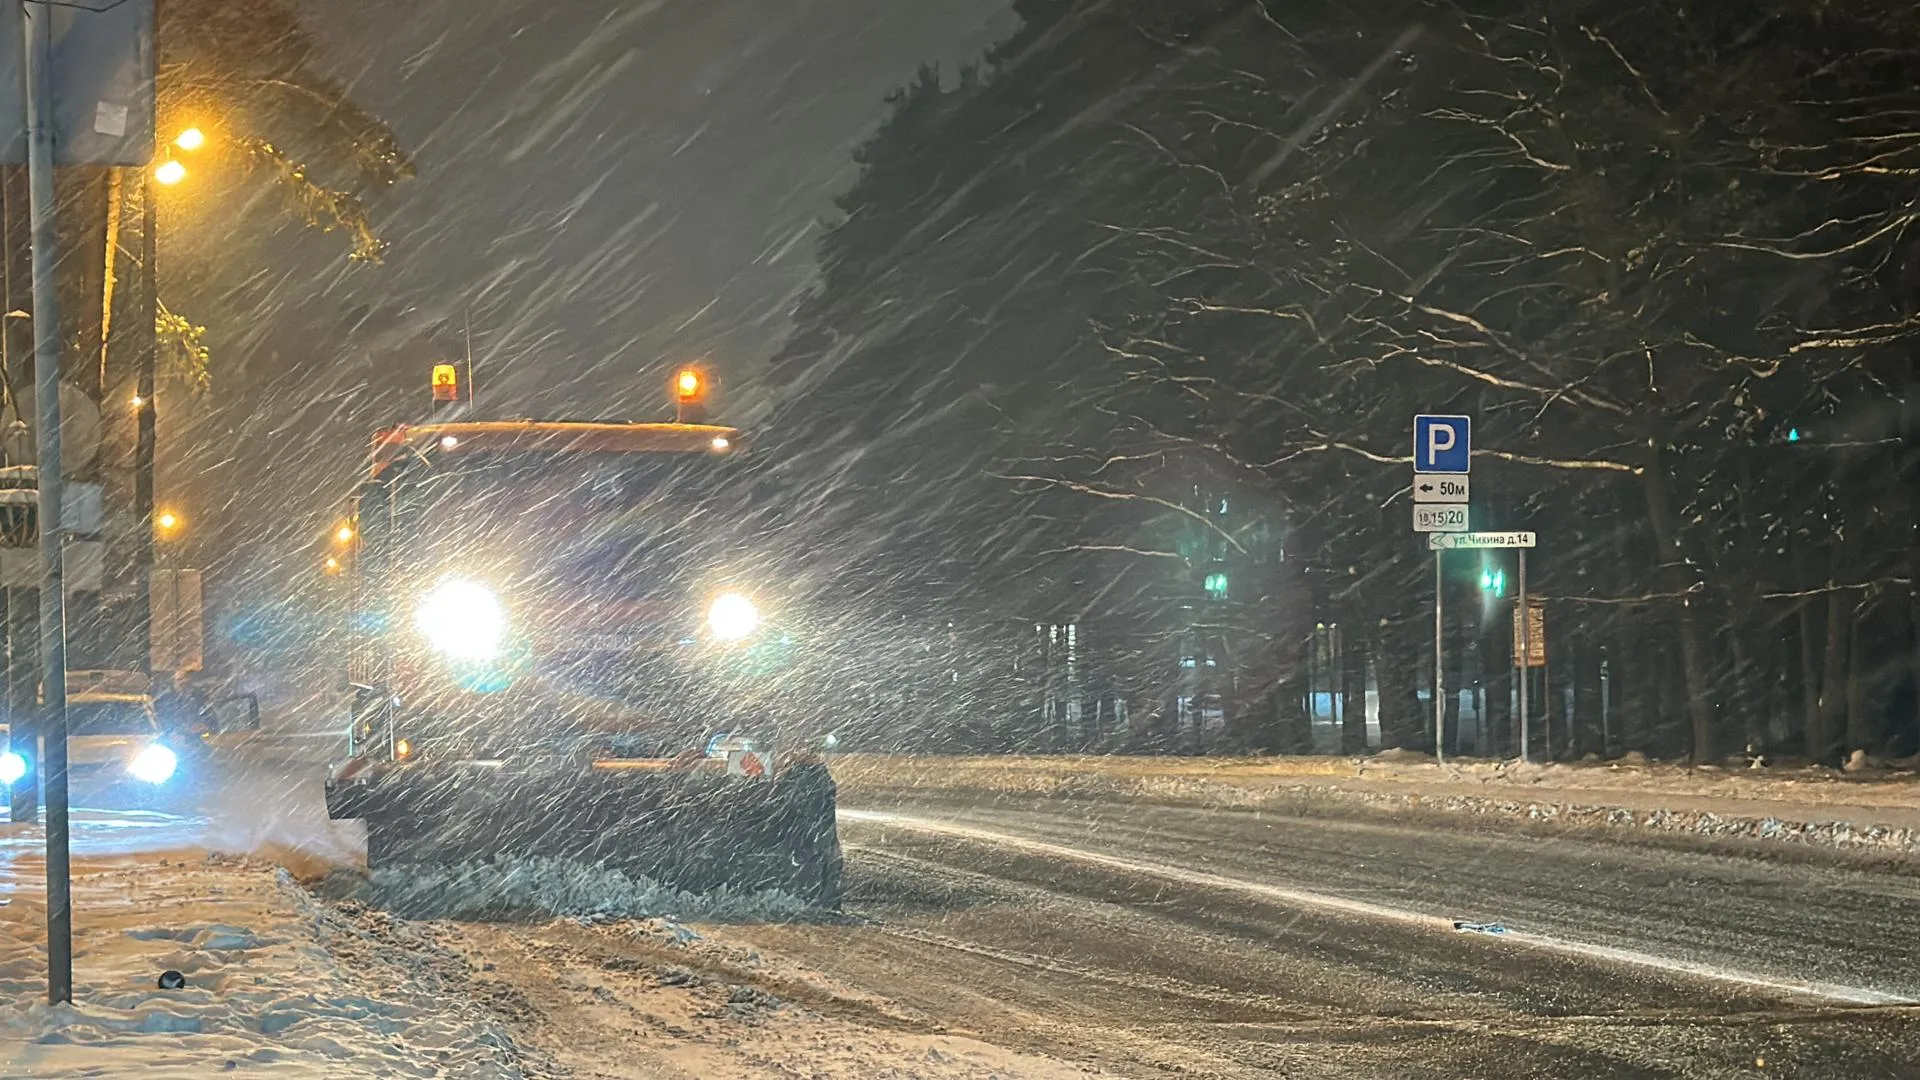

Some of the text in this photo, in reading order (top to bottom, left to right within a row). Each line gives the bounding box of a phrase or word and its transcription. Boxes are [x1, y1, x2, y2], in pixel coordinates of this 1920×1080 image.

[1428, 423, 1456, 465] P
[1431, 511, 1444, 524] 15
[1448, 510, 1464, 524] 20
